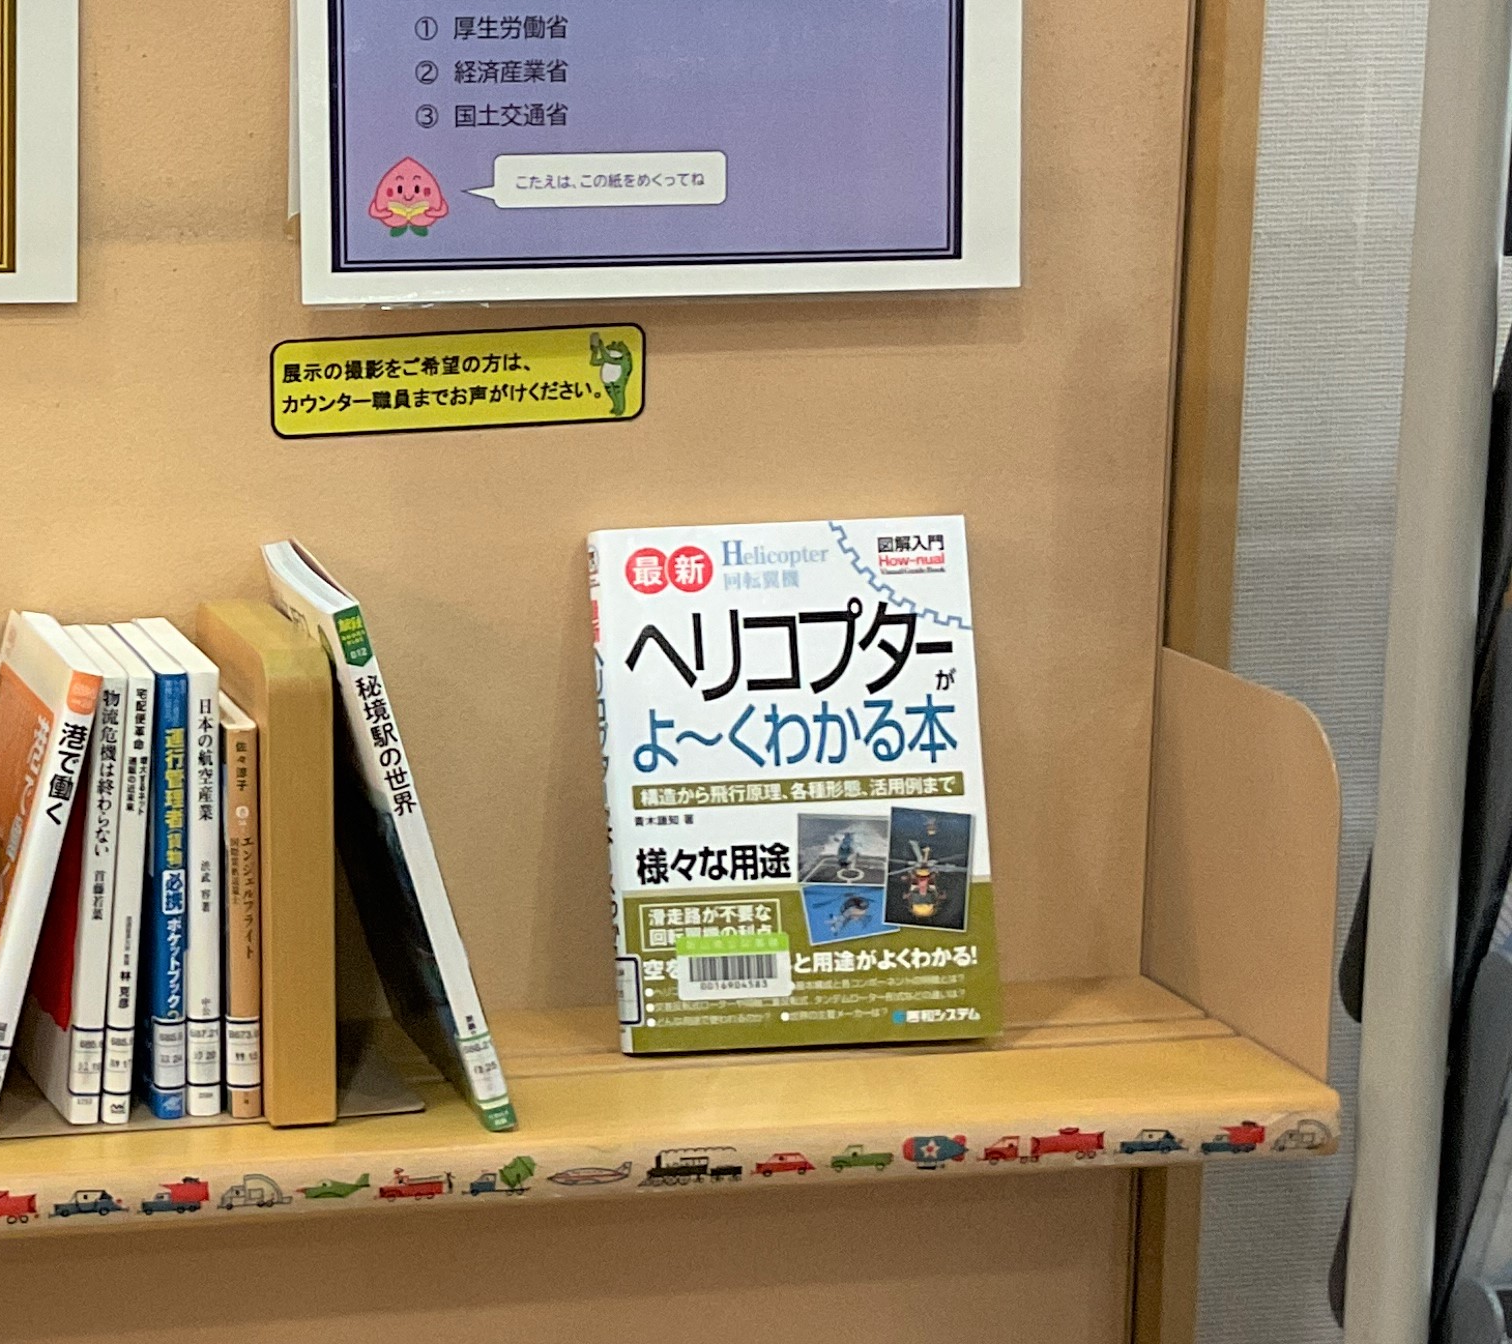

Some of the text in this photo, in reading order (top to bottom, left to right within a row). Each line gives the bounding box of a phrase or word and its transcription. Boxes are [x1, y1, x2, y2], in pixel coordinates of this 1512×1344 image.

[452, 15, 569, 42] 厚生労働省
[453, 59, 570, 86] 経済産業省
[453, 103, 570, 130] 国土交通省
[514, 169, 707, 192] こたえは、この紙をめくってね
[281, 352, 533, 384] 展示の撮影をご希望の方は、
[281, 380, 603, 415] カウンター職員までお声がけください。
[720, 540, 830, 568] Helicopter
[877, 534, 945, 554] 図解入門
[632, 553, 707, 586] 最新
[878, 553, 946, 568] How-nual
[197, 697, 215, 823] 日本の航空産業
[354, 674, 418, 818] 秘境駅の世界
[45, 721, 89, 826] 港で働く
[93, 688, 121, 857] 物流危機は終わらない
[640, 775, 957, 807] 構造から飛行原理、各種形態、活用例まで
[635, 842, 793, 886] 様々な用途
[241, 836, 257, 960] エンジェルフライト
